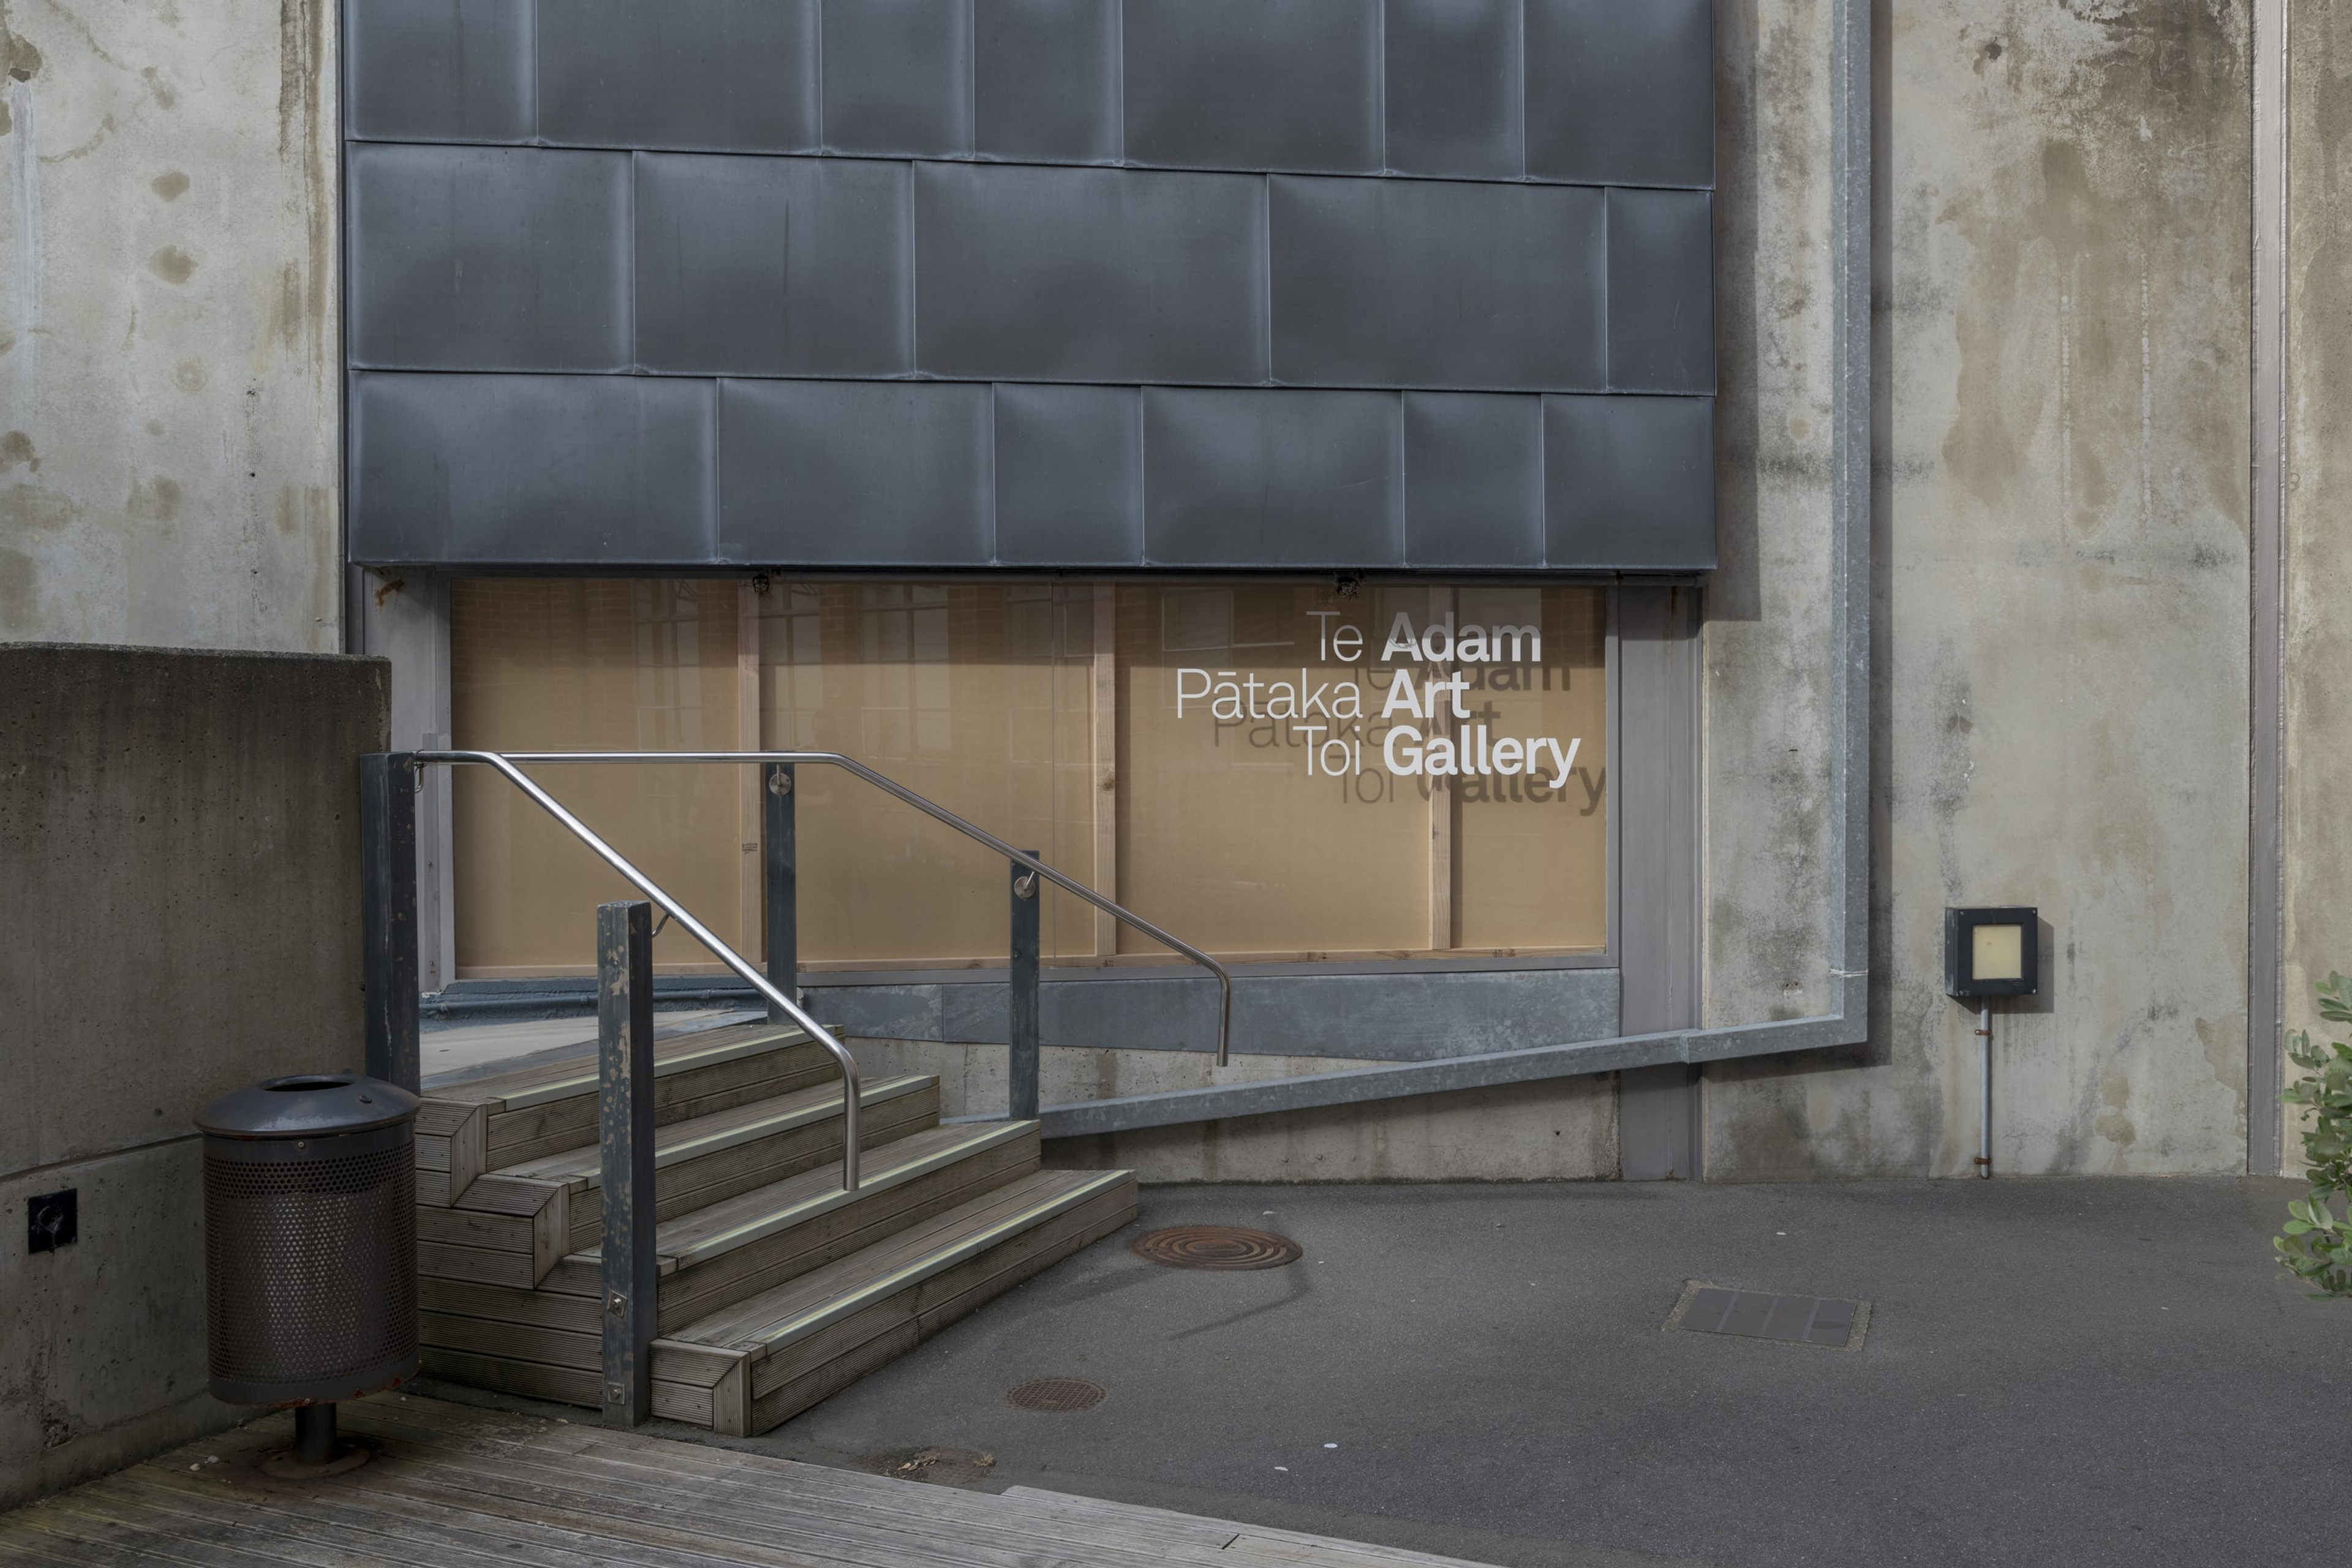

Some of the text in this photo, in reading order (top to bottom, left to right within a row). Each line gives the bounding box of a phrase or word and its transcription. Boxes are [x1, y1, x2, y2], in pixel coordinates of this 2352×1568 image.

[1306, 611, 1542, 662] Te Adam
[1177, 668, 1471, 719] Pātaka Art
[1292, 725, 1581, 789] Toi Gallery
